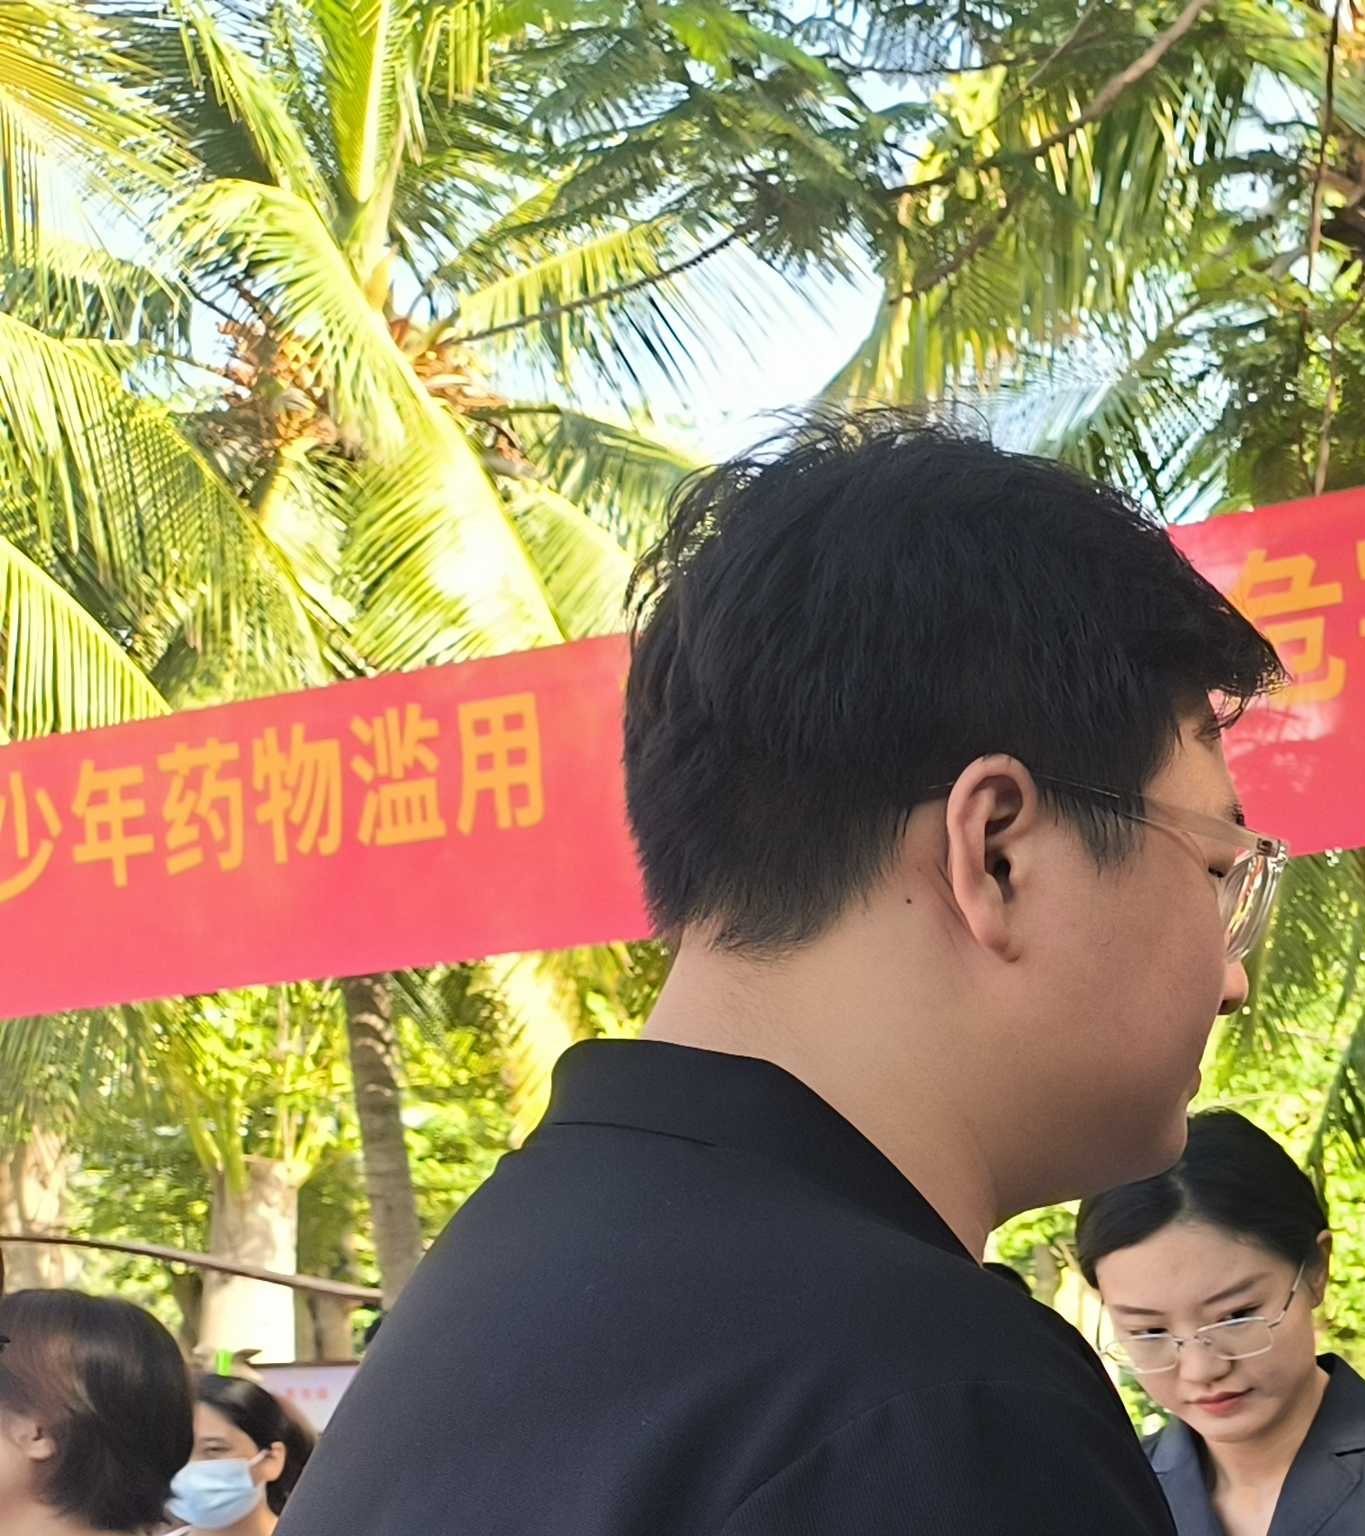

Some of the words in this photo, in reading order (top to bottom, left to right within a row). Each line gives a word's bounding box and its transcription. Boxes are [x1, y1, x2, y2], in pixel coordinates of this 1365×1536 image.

[0, 693, 546, 902] 少年药物滥用
